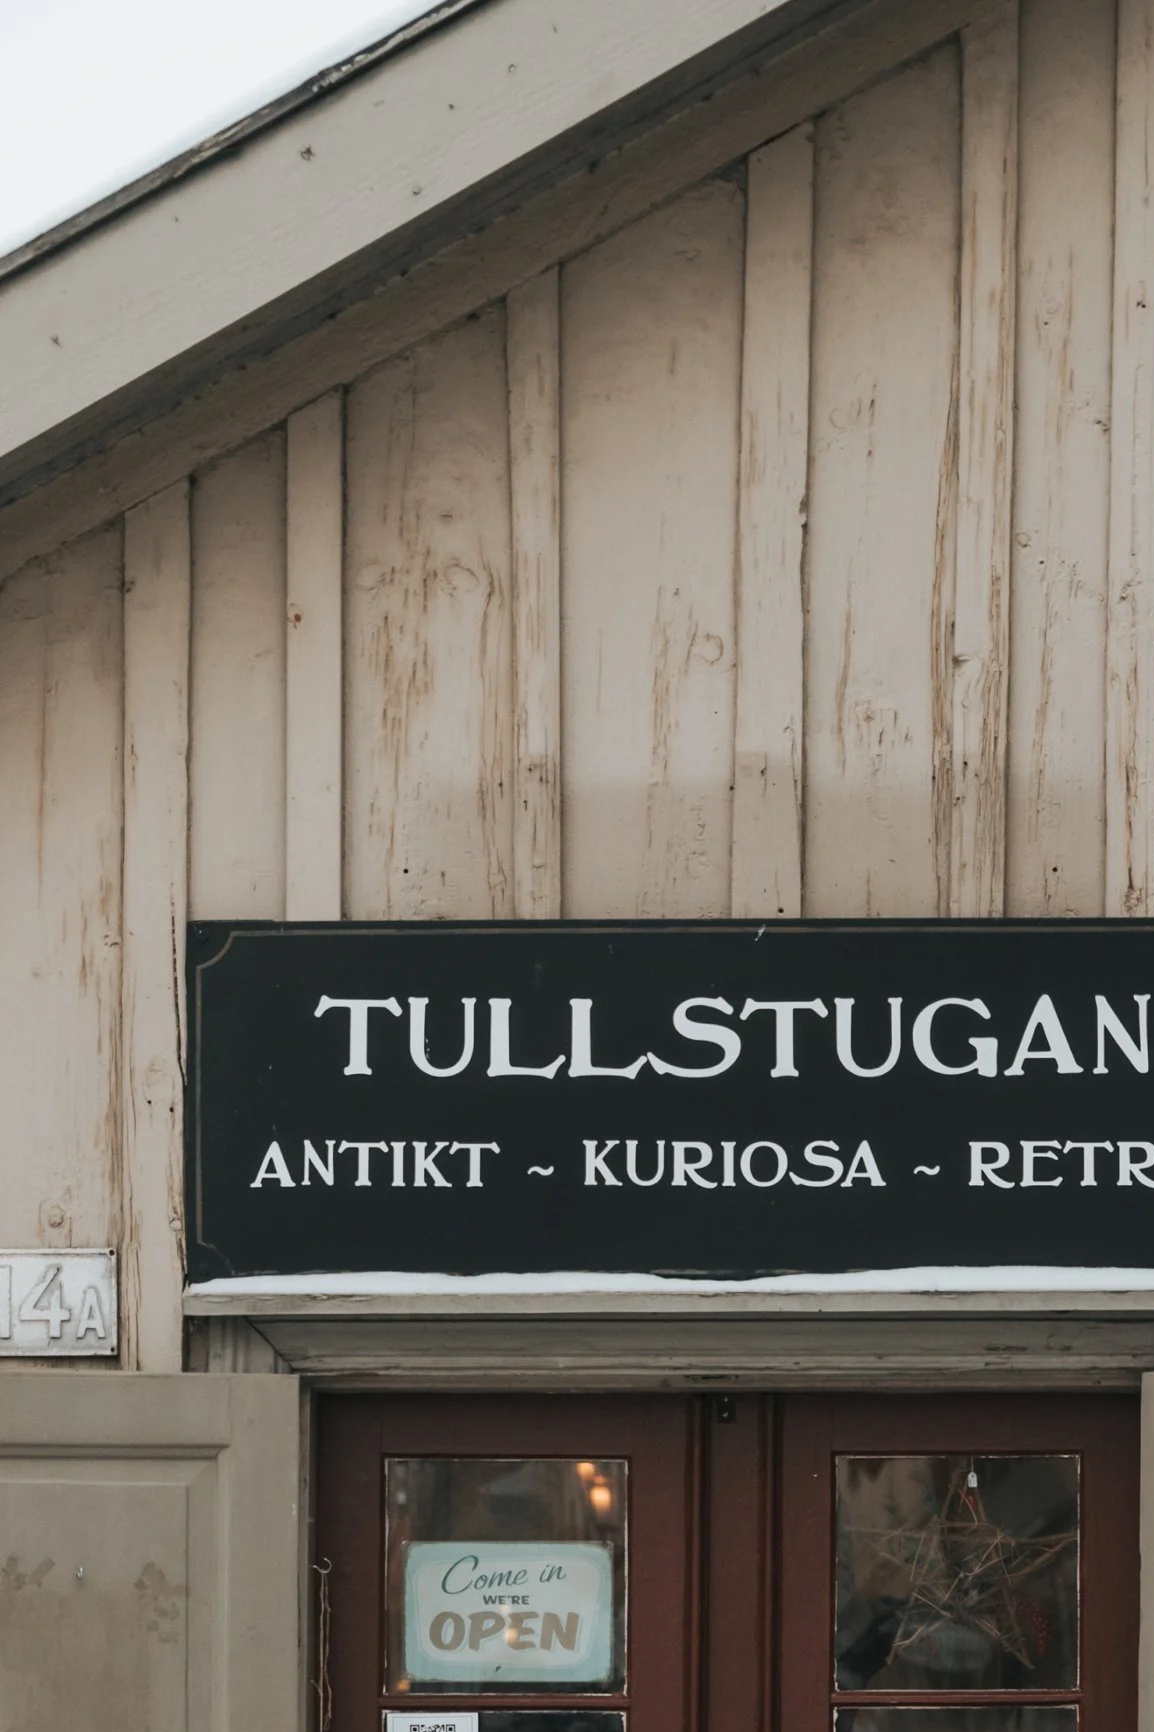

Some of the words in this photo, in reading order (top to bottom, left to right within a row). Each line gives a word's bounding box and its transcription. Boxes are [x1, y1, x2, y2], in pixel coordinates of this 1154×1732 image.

[313, 993, 1154, 1079] TULLSTUGAN
[249, 1139, 501, 1189] ANTIKT
[582, 1139, 888, 1189] KURIOSA
[440, 1554, 529, 1595] Come
[538, 1561, 567, 1584] in
[428, 1610, 580, 1652] OPEN
